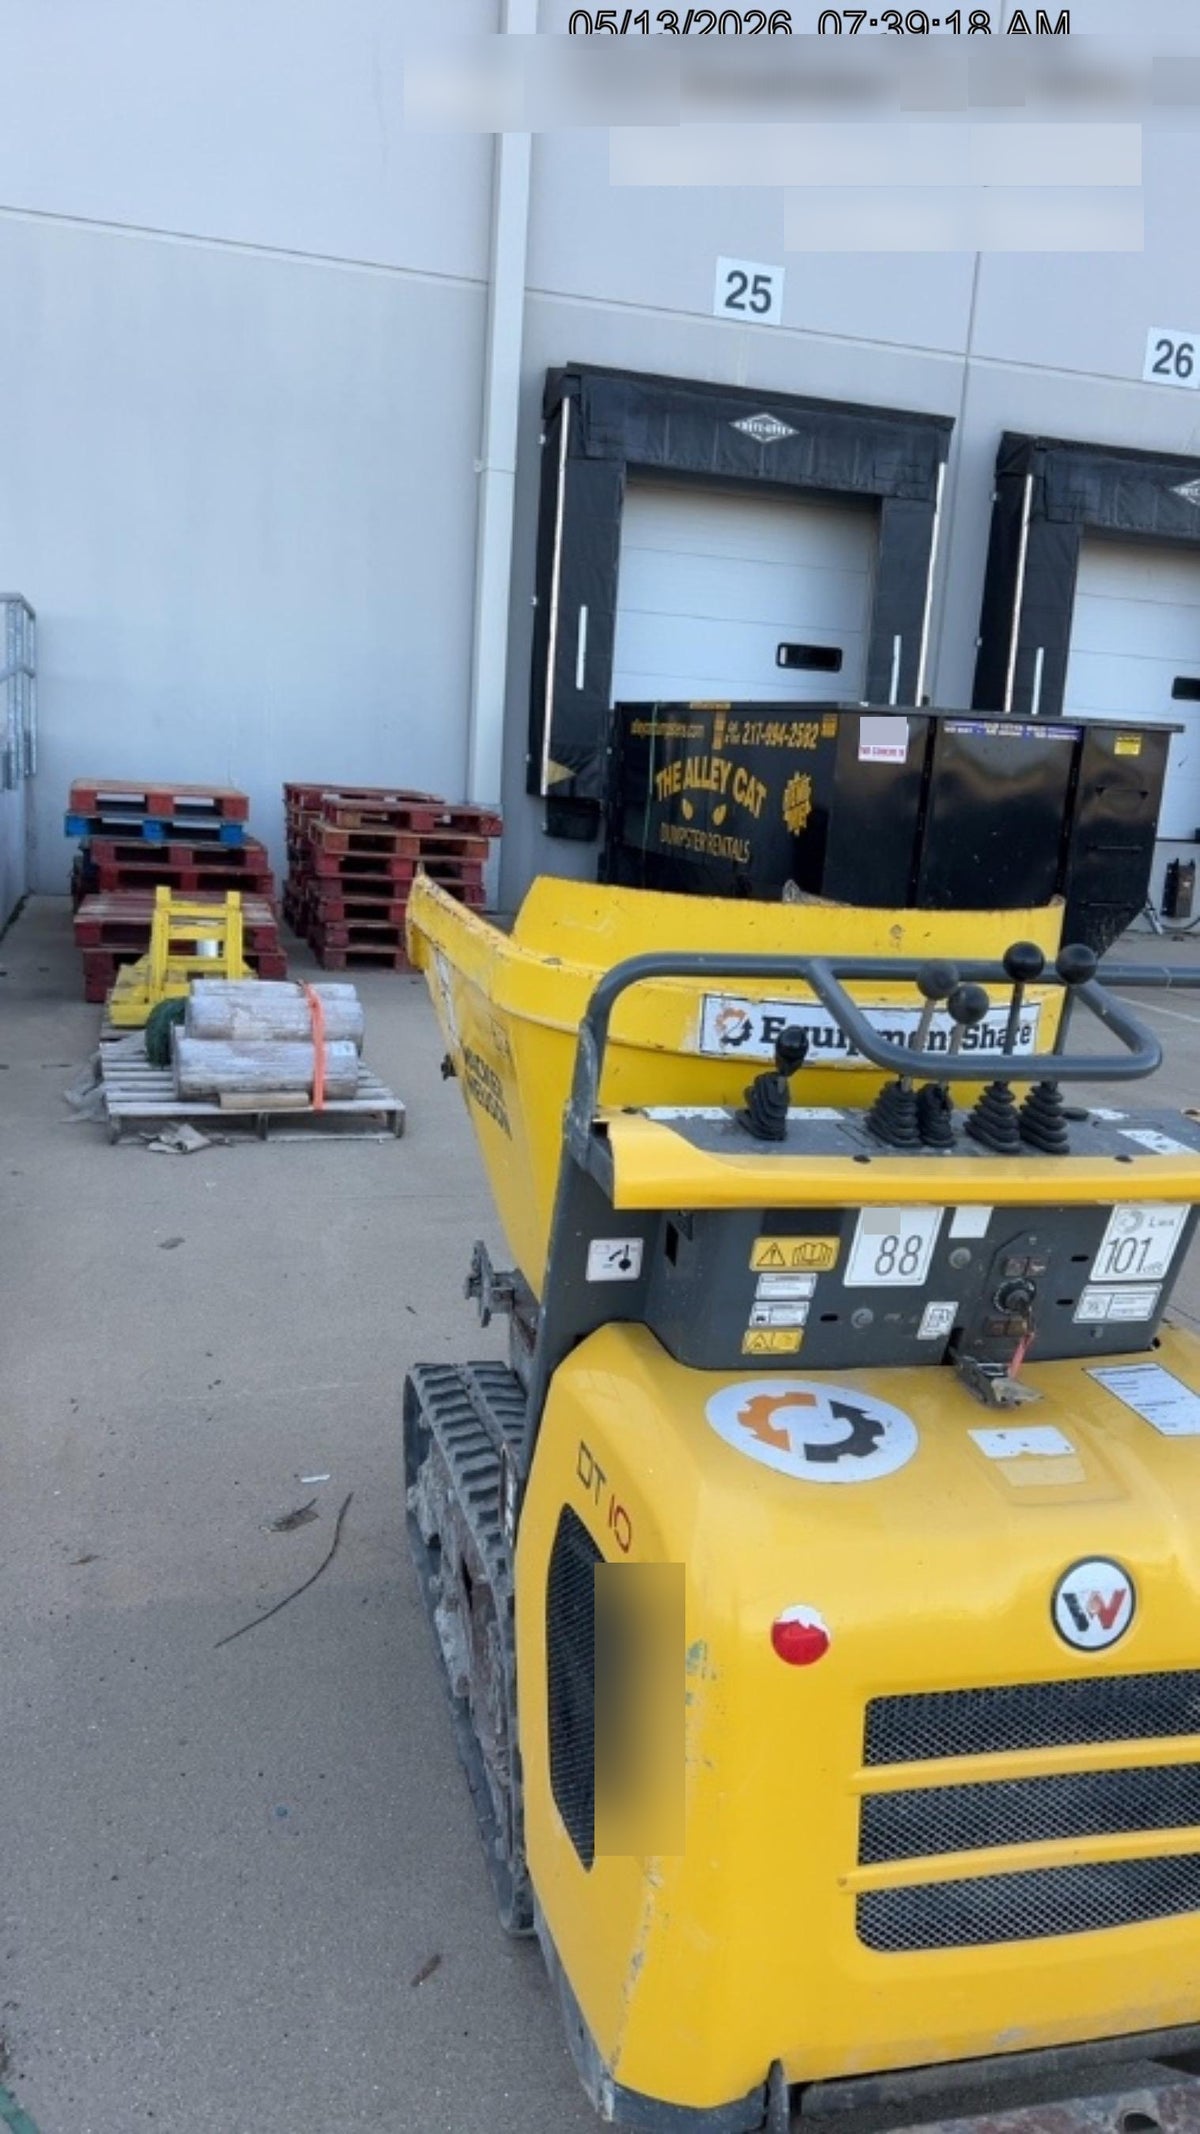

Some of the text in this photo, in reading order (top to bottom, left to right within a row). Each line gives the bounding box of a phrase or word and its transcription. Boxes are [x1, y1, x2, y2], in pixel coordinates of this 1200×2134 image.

[724, 270, 773, 314] 25
[1151, 339, 1194, 379] 26
[656, 761, 682, 802] THE
[683, 756, 733, 794] ALLEY
[732, 768, 767, 818] CAT
[660, 822, 750, 864] DUMPSTER RENTALS
[874, 1235, 923, 1276] 88
[1103, 1236, 1153, 1275] 101
[577, 1439, 632, 1554] DT 10
